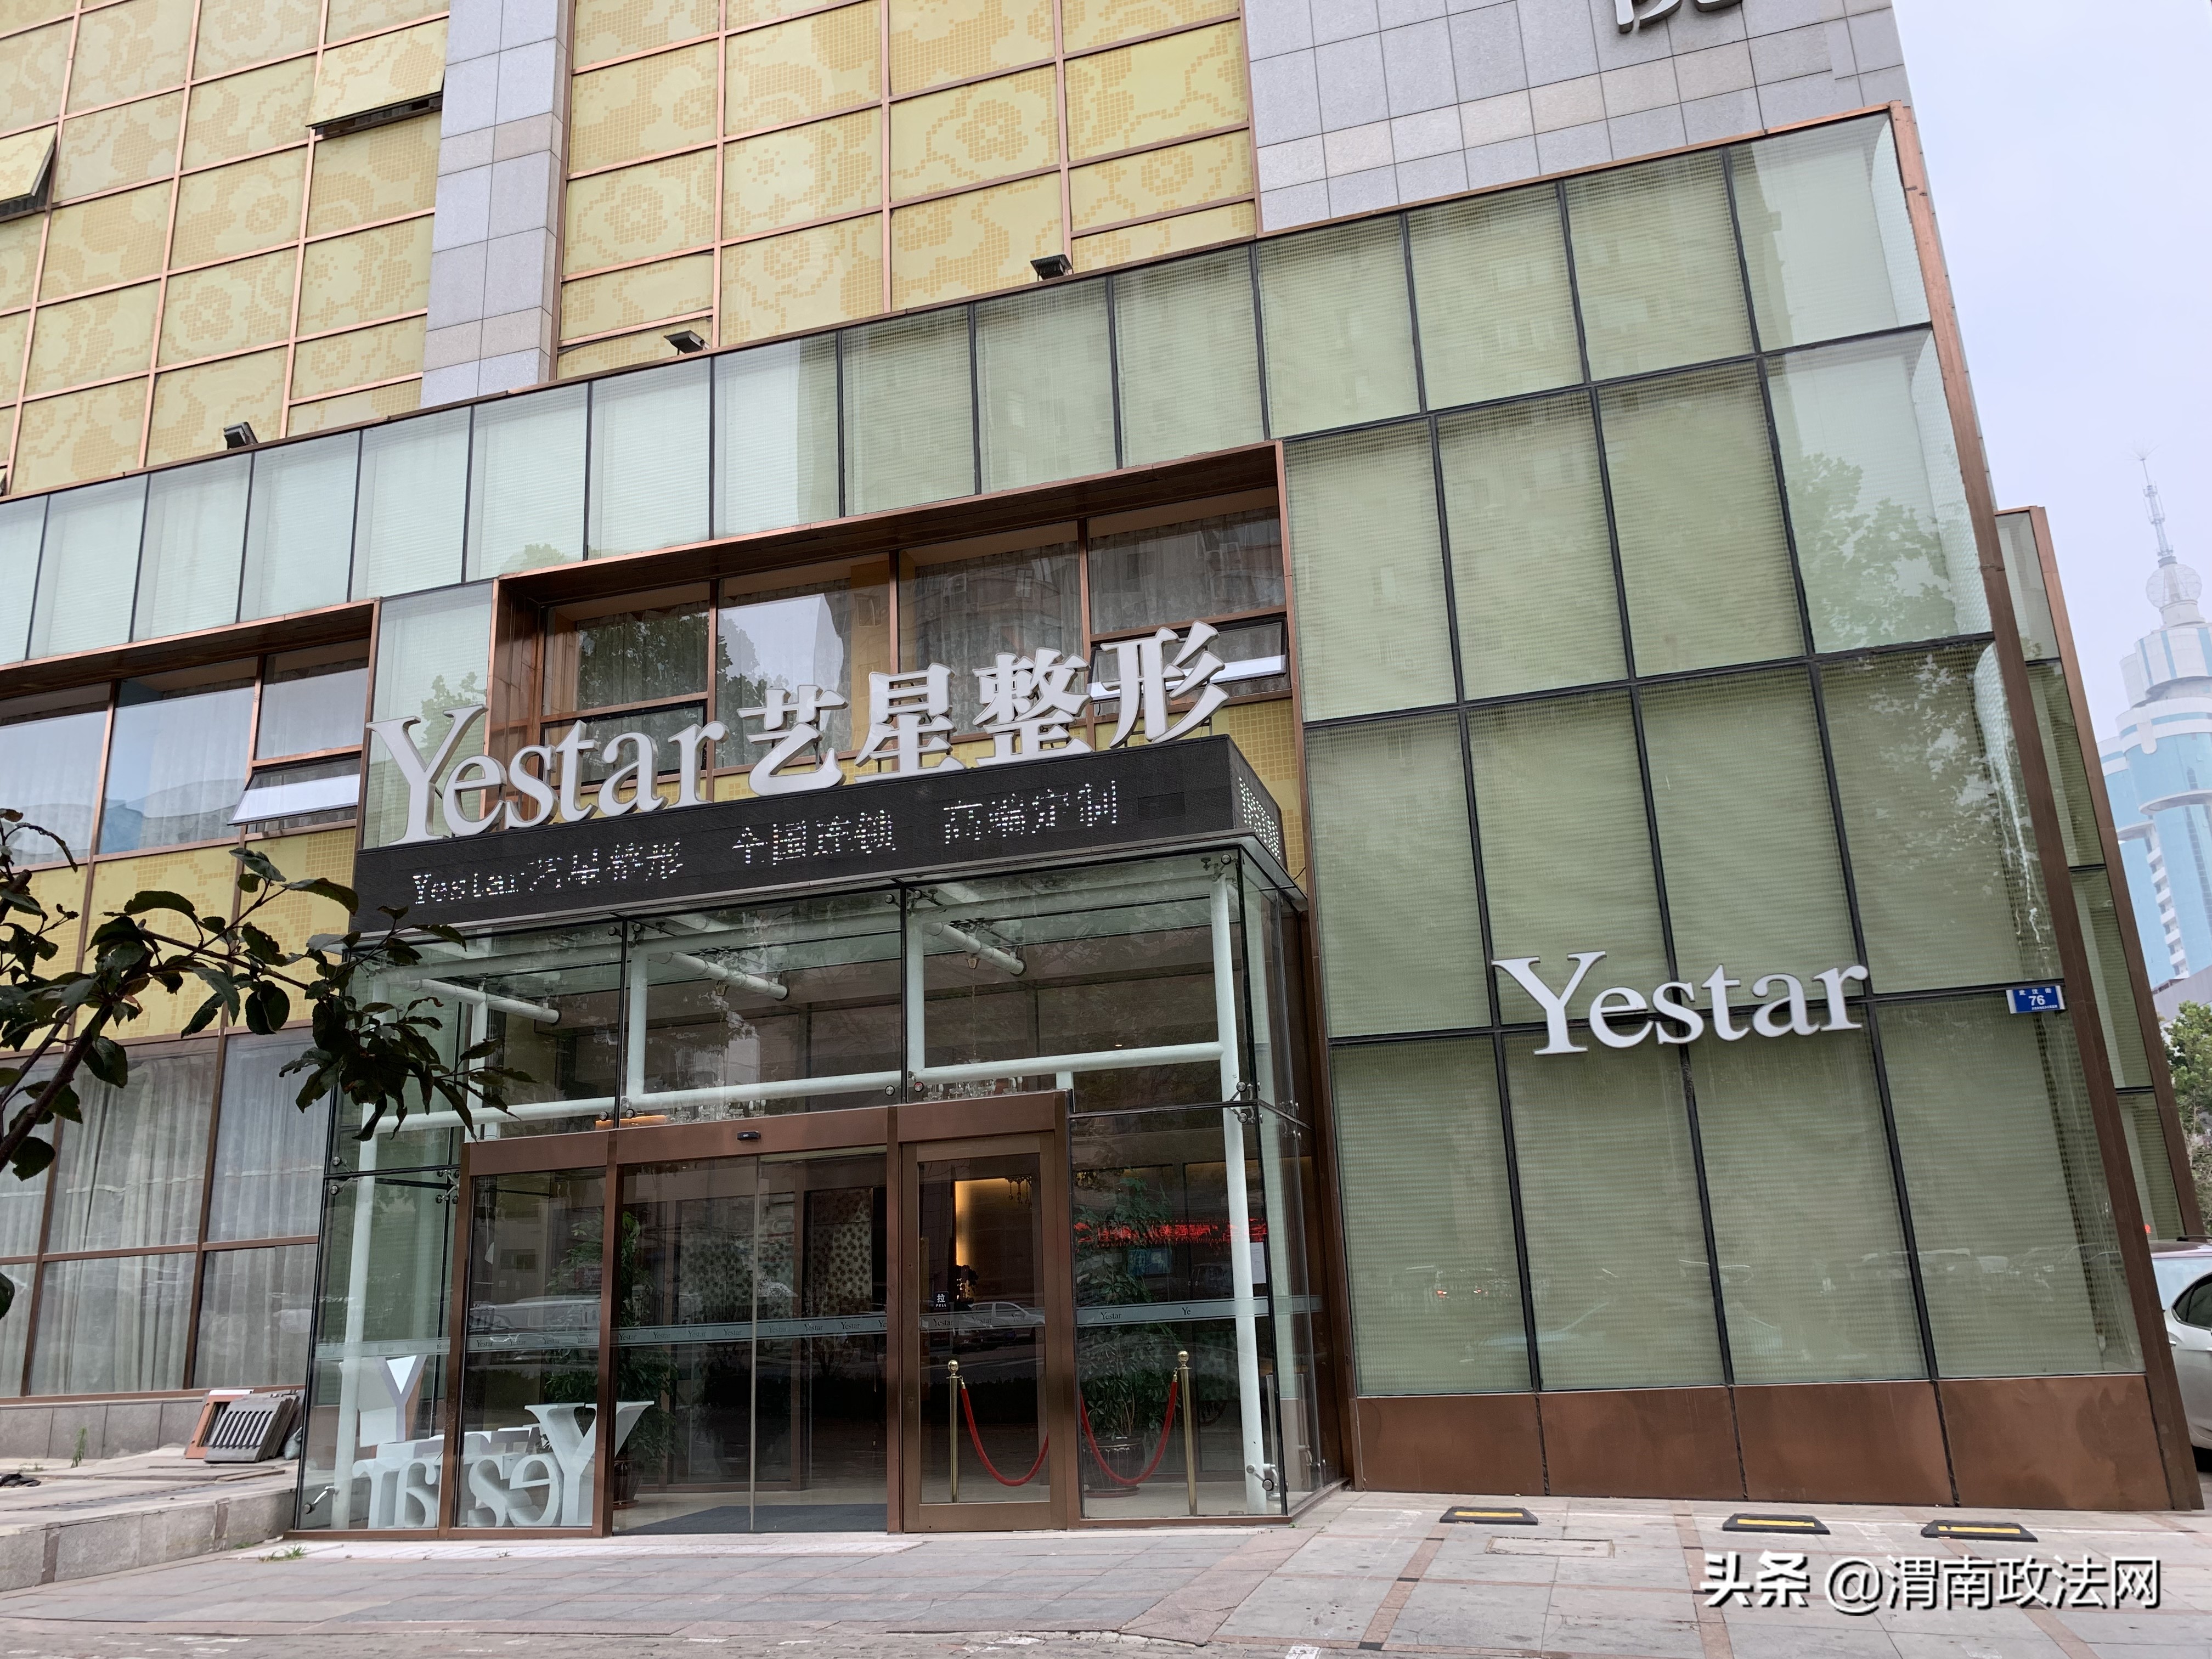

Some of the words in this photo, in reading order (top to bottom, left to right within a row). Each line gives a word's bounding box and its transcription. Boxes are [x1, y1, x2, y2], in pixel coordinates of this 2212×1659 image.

[366, 704, 729, 845] Yestar
[737, 620, 1230, 797] 艺星整形
[1491, 951, 1868, 1056] Yestar
[2028, 995, 2046, 1006] 76
[937, 1294, 945, 1303] 拉
[1101, 1311, 1122, 1320] Yestar
[724, 1328, 742, 1336] Yestar
[804, 1323, 823, 1332] Yestar
[840, 1321, 860, 1330] Yestar
